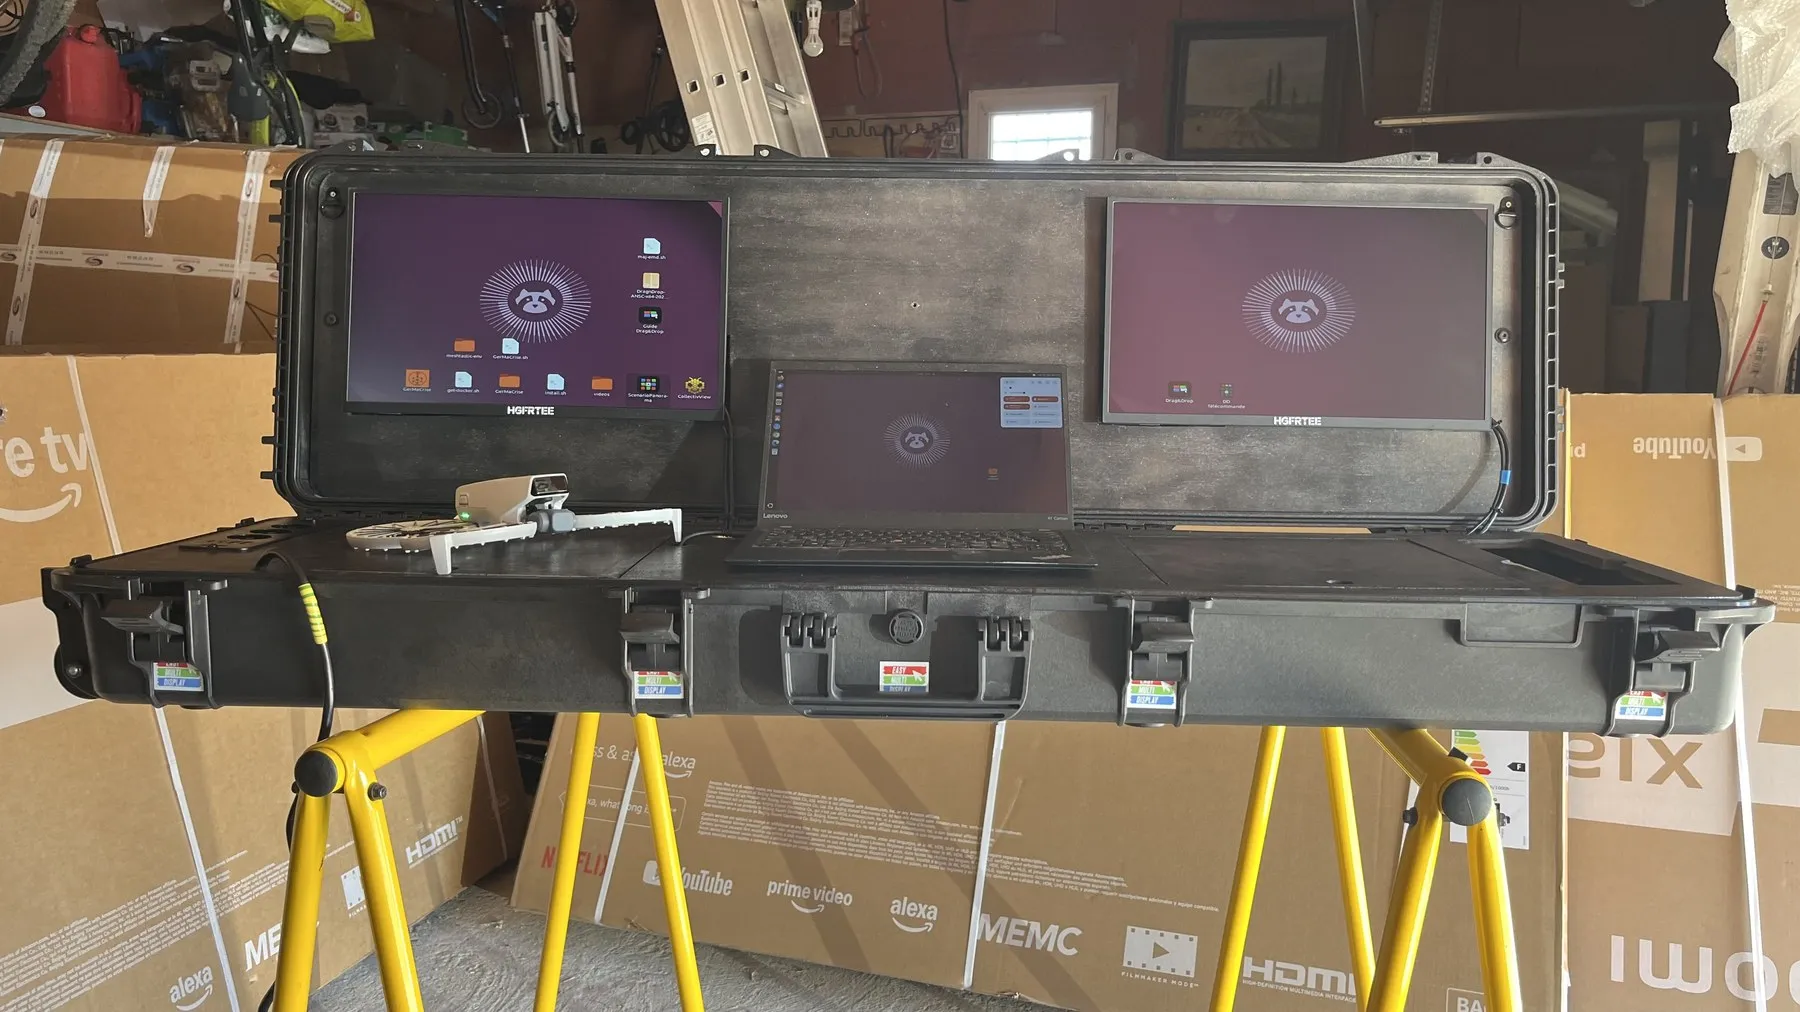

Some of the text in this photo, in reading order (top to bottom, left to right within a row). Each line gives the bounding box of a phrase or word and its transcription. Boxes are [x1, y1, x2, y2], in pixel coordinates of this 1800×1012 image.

[506, 405, 555, 415] HGFRTEE
[1273, 416, 1322, 426] HGFRTEE
[1633, 437, 1717, 460] YouTube
[0, 437, 35, 478] e
[891, 666, 907, 674] EASY
[163, 678, 186, 686] DISPLAY
[643, 686, 667, 694] DISPLAY
[1135, 696, 1159, 704] DISPLAY
[1624, 707, 1648, 716] DISPLAY
[606, 745, 617, 760] &
[1516, 763, 1522, 771] F
[767, 879, 853, 907] prime video
[890, 896, 938, 921] alexa
[977, 912, 1083, 957] MEMC
[244, 921, 283, 973] ME
[1121, 971, 1168, 985] FILMMAKER
[1243, 955, 1356, 996] HDMI
[1611, 934, 1800, 1006] omi
[169, 965, 213, 1004] alexa
[1242, 979, 1288, 993] HIGH-DEFINITION
[1289, 986, 1324, 998] MULTIMEDIA
